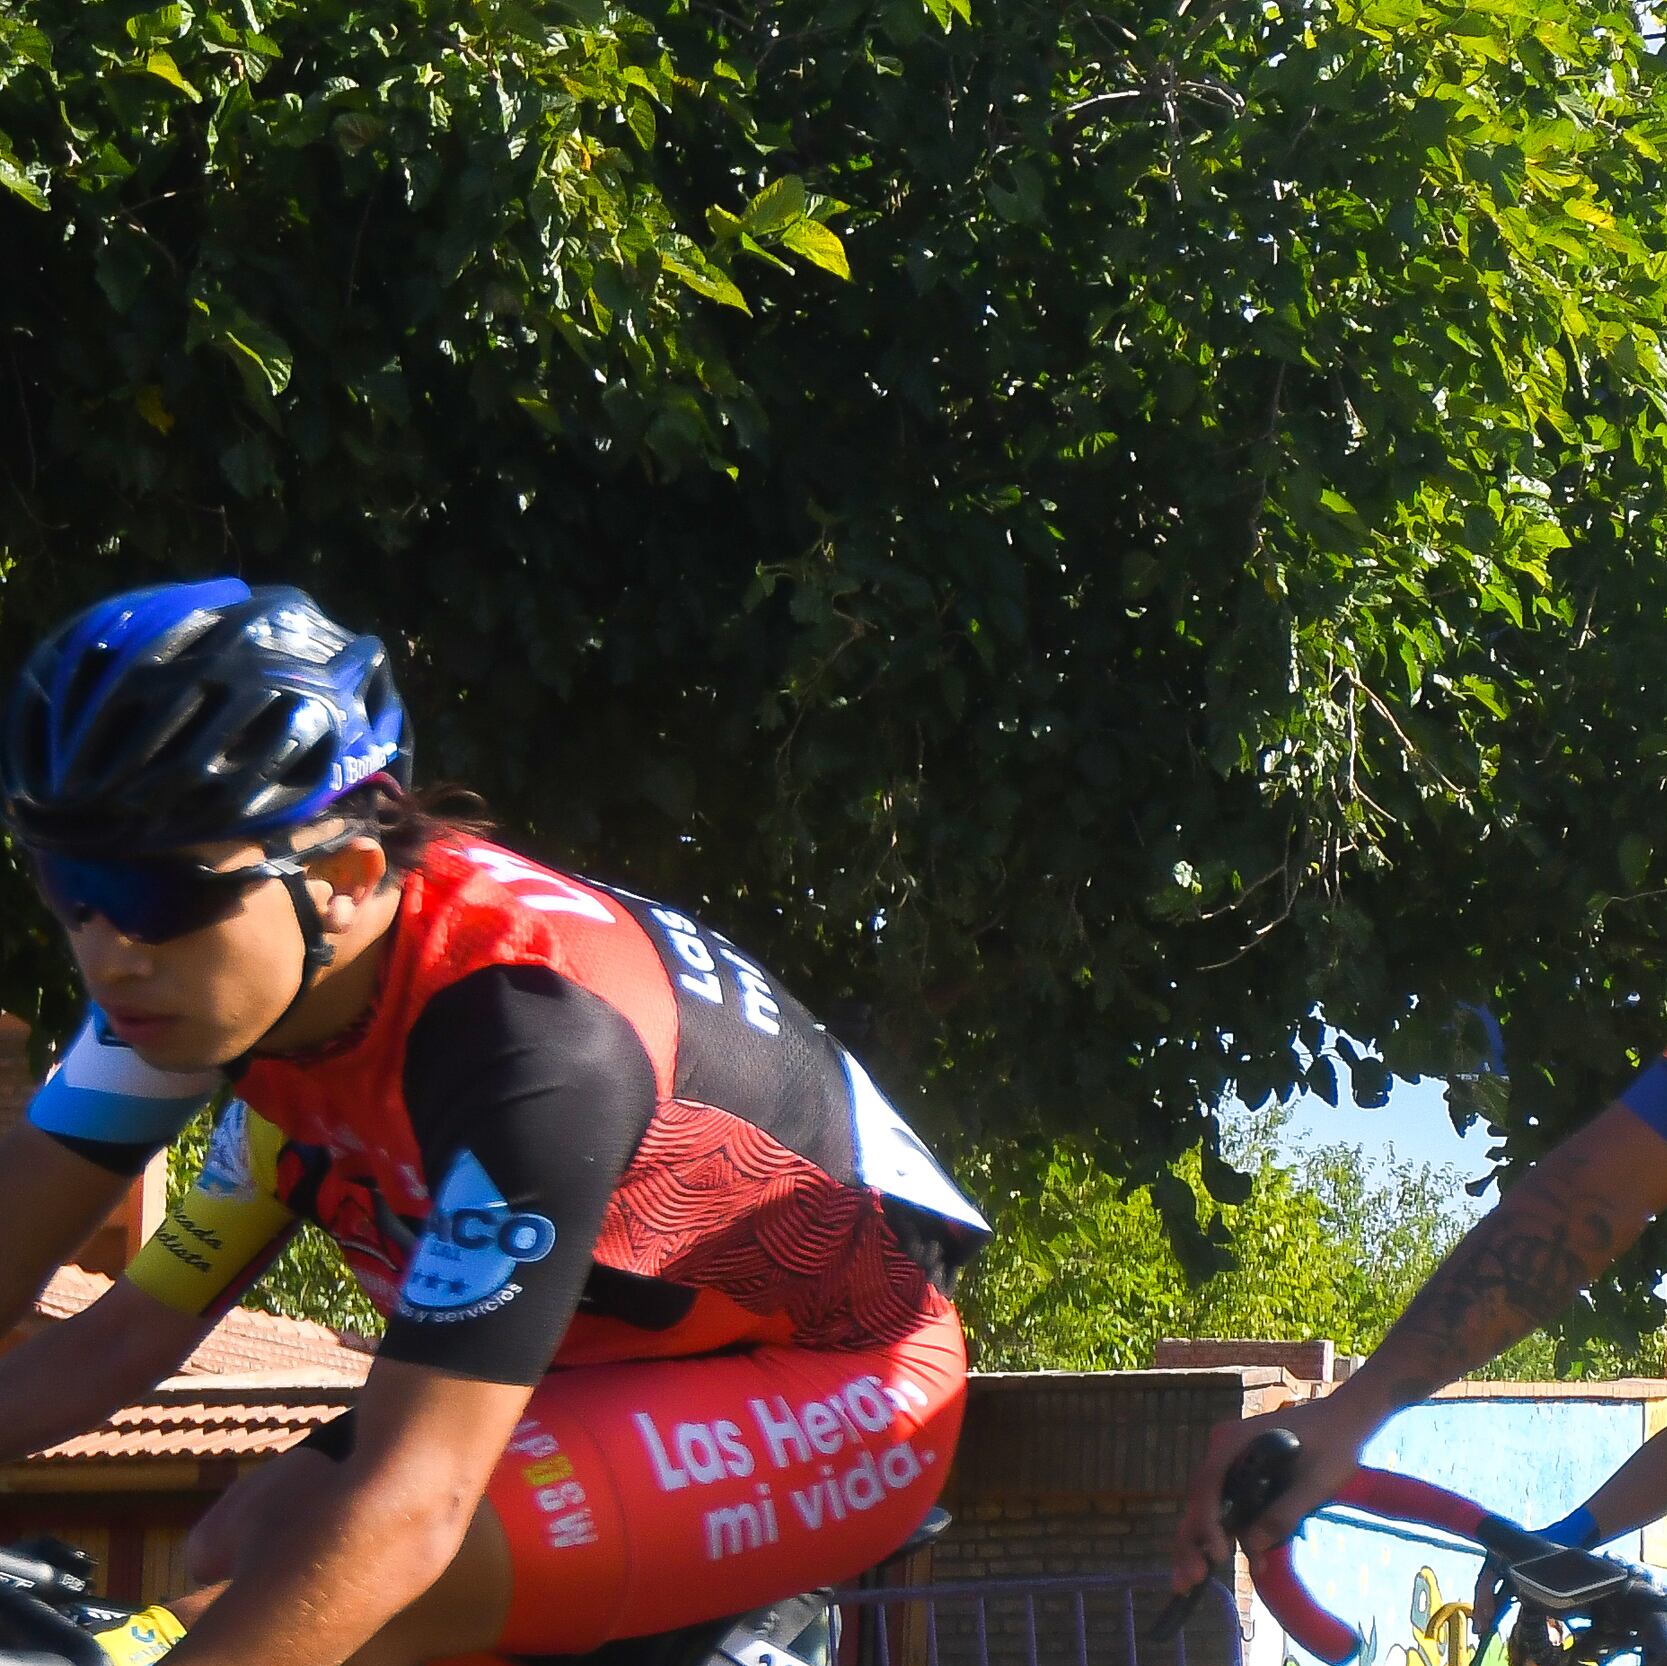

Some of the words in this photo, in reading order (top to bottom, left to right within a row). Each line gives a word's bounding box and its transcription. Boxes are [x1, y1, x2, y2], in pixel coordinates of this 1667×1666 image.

[633, 1411, 757, 1493] Las
[704, 1483, 780, 1561] mi
[793, 1442, 937, 1531] vida.
